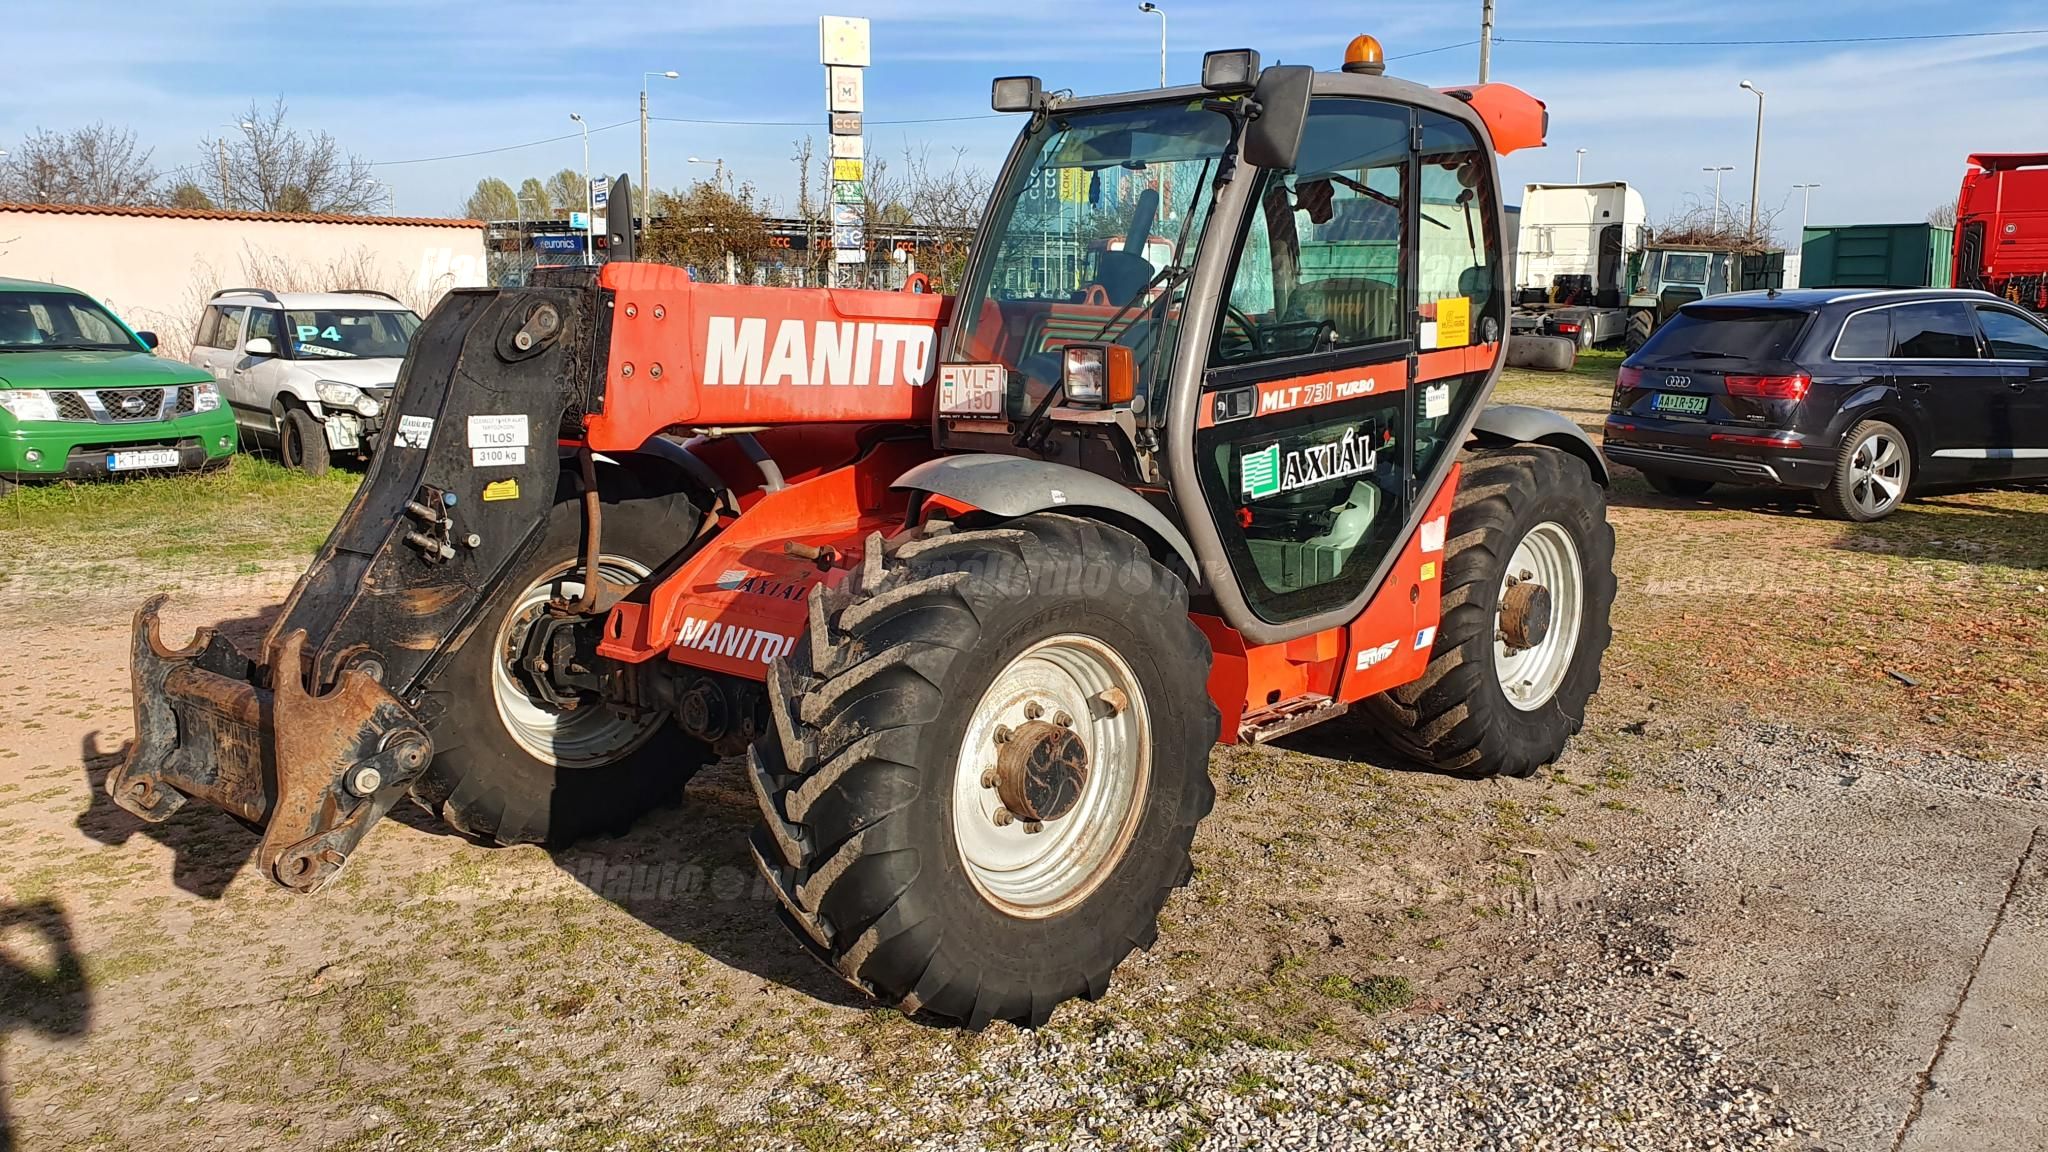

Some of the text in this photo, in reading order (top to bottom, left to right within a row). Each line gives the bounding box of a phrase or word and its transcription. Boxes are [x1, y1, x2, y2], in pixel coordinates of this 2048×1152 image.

[835, 118, 860, 130] CCC
[544, 240, 575, 249] euronics
[896, 242, 916, 252] CCC
[296, 325, 342, 342] P4
[962, 368, 995, 389] YLF
[943, 390, 953, 404] H
[966, 391, 992, 410] 150
[1261, 378, 1375, 412] MLT 731 TURBO
[1659, 395, 1705, 410] AA IR-571
[483, 433, 515, 443] TILOS!
[118, 452, 176, 466] KTH-904
[479, 450, 517, 462] 3100 kg
[1282, 427, 1376, 489] AXIÁL
